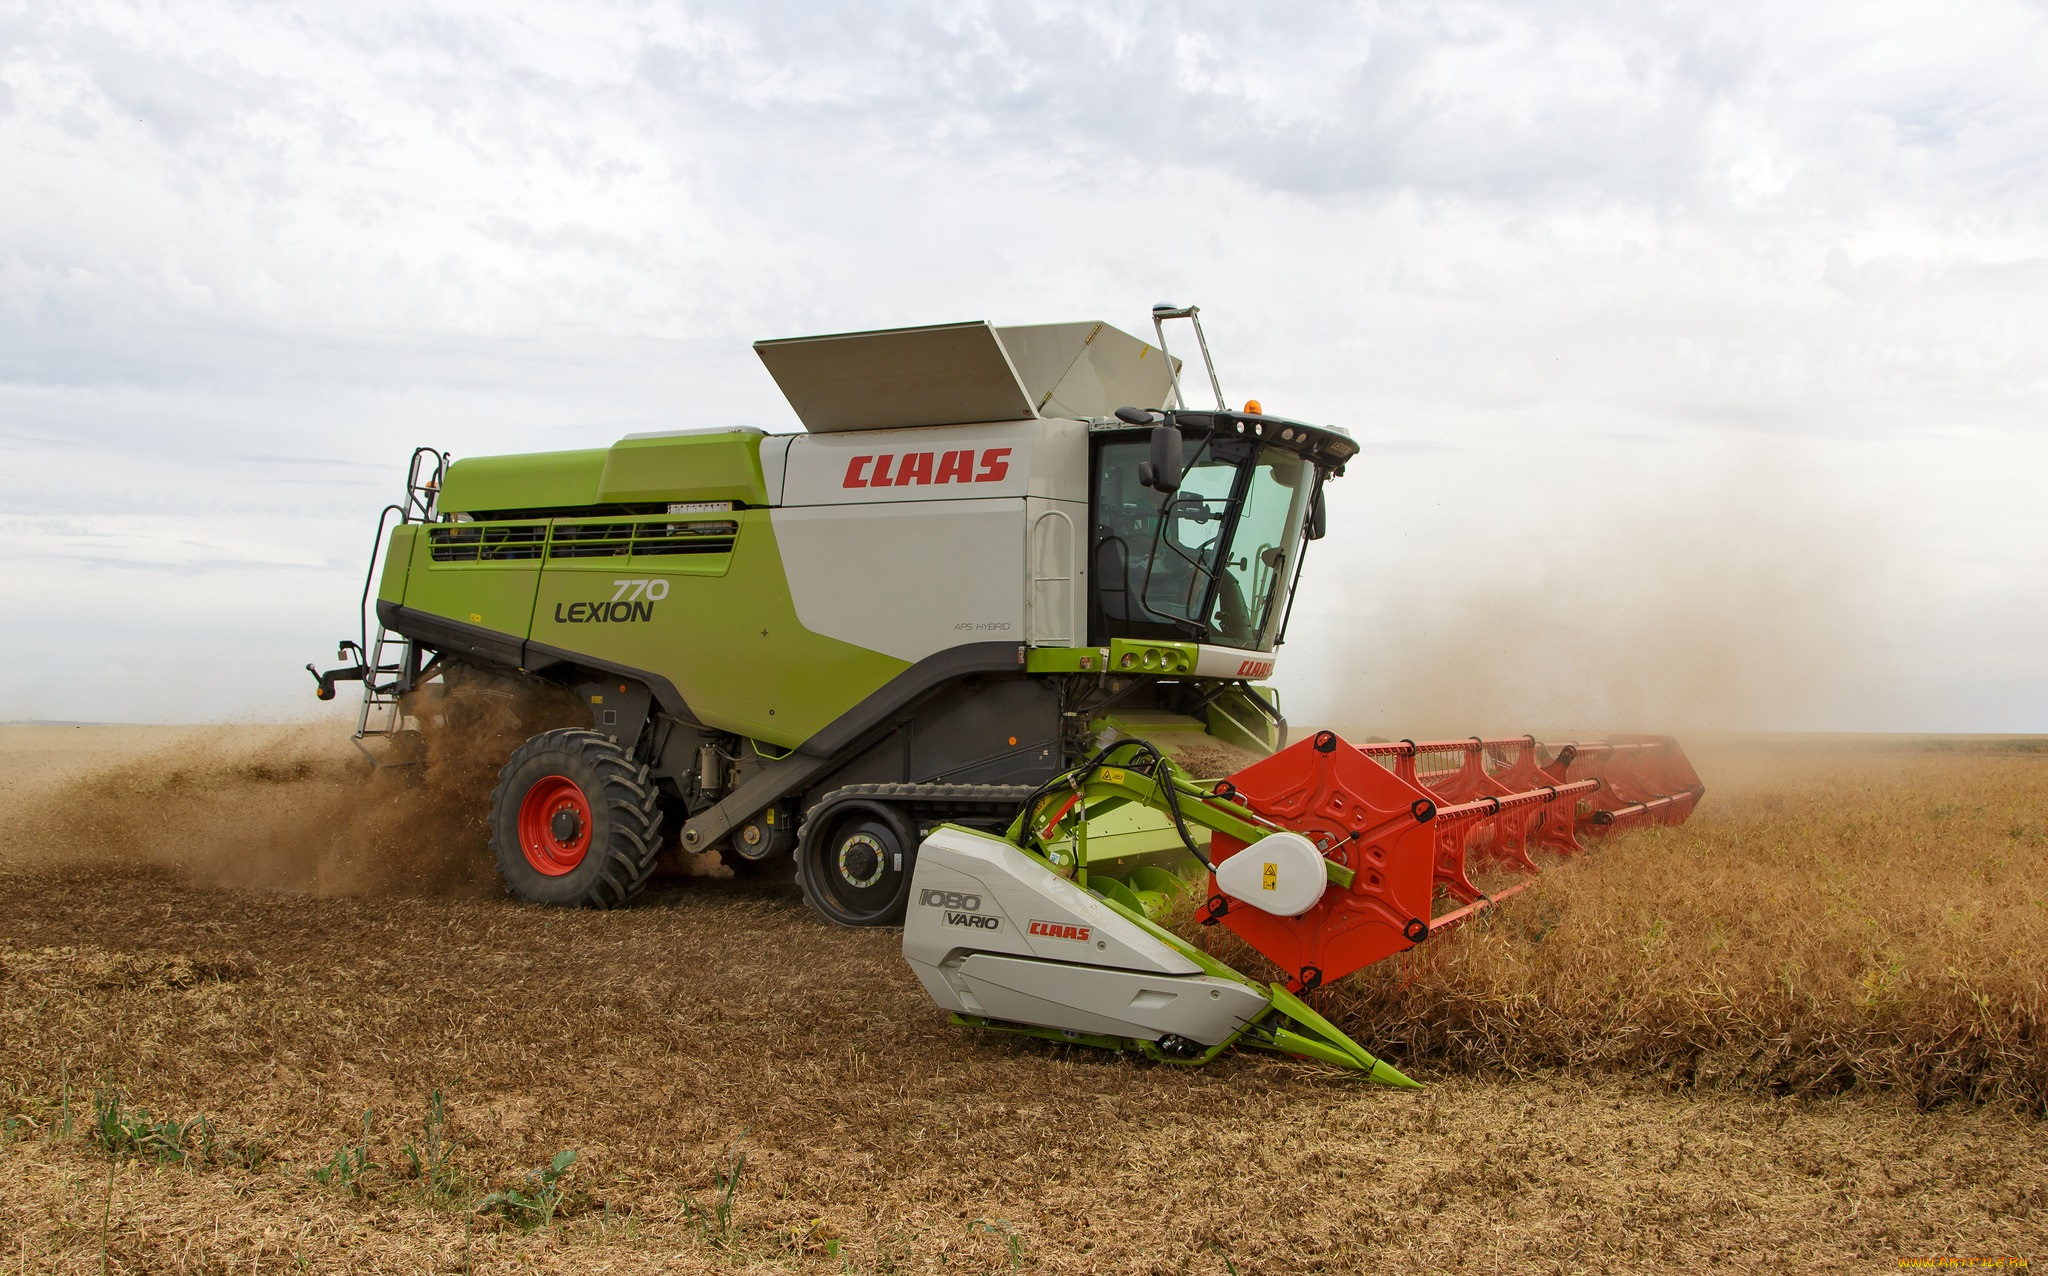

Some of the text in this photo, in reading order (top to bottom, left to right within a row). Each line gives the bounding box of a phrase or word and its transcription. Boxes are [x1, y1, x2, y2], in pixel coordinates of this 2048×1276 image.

[843, 448, 1012, 488] CLAAS
[611, 579, 669, 601] 770
[555, 601, 654, 623] LEXION
[920, 891, 981, 912] 1080
[947, 912, 999, 930] VARIO
[1029, 922, 1090, 941] CLAAS
